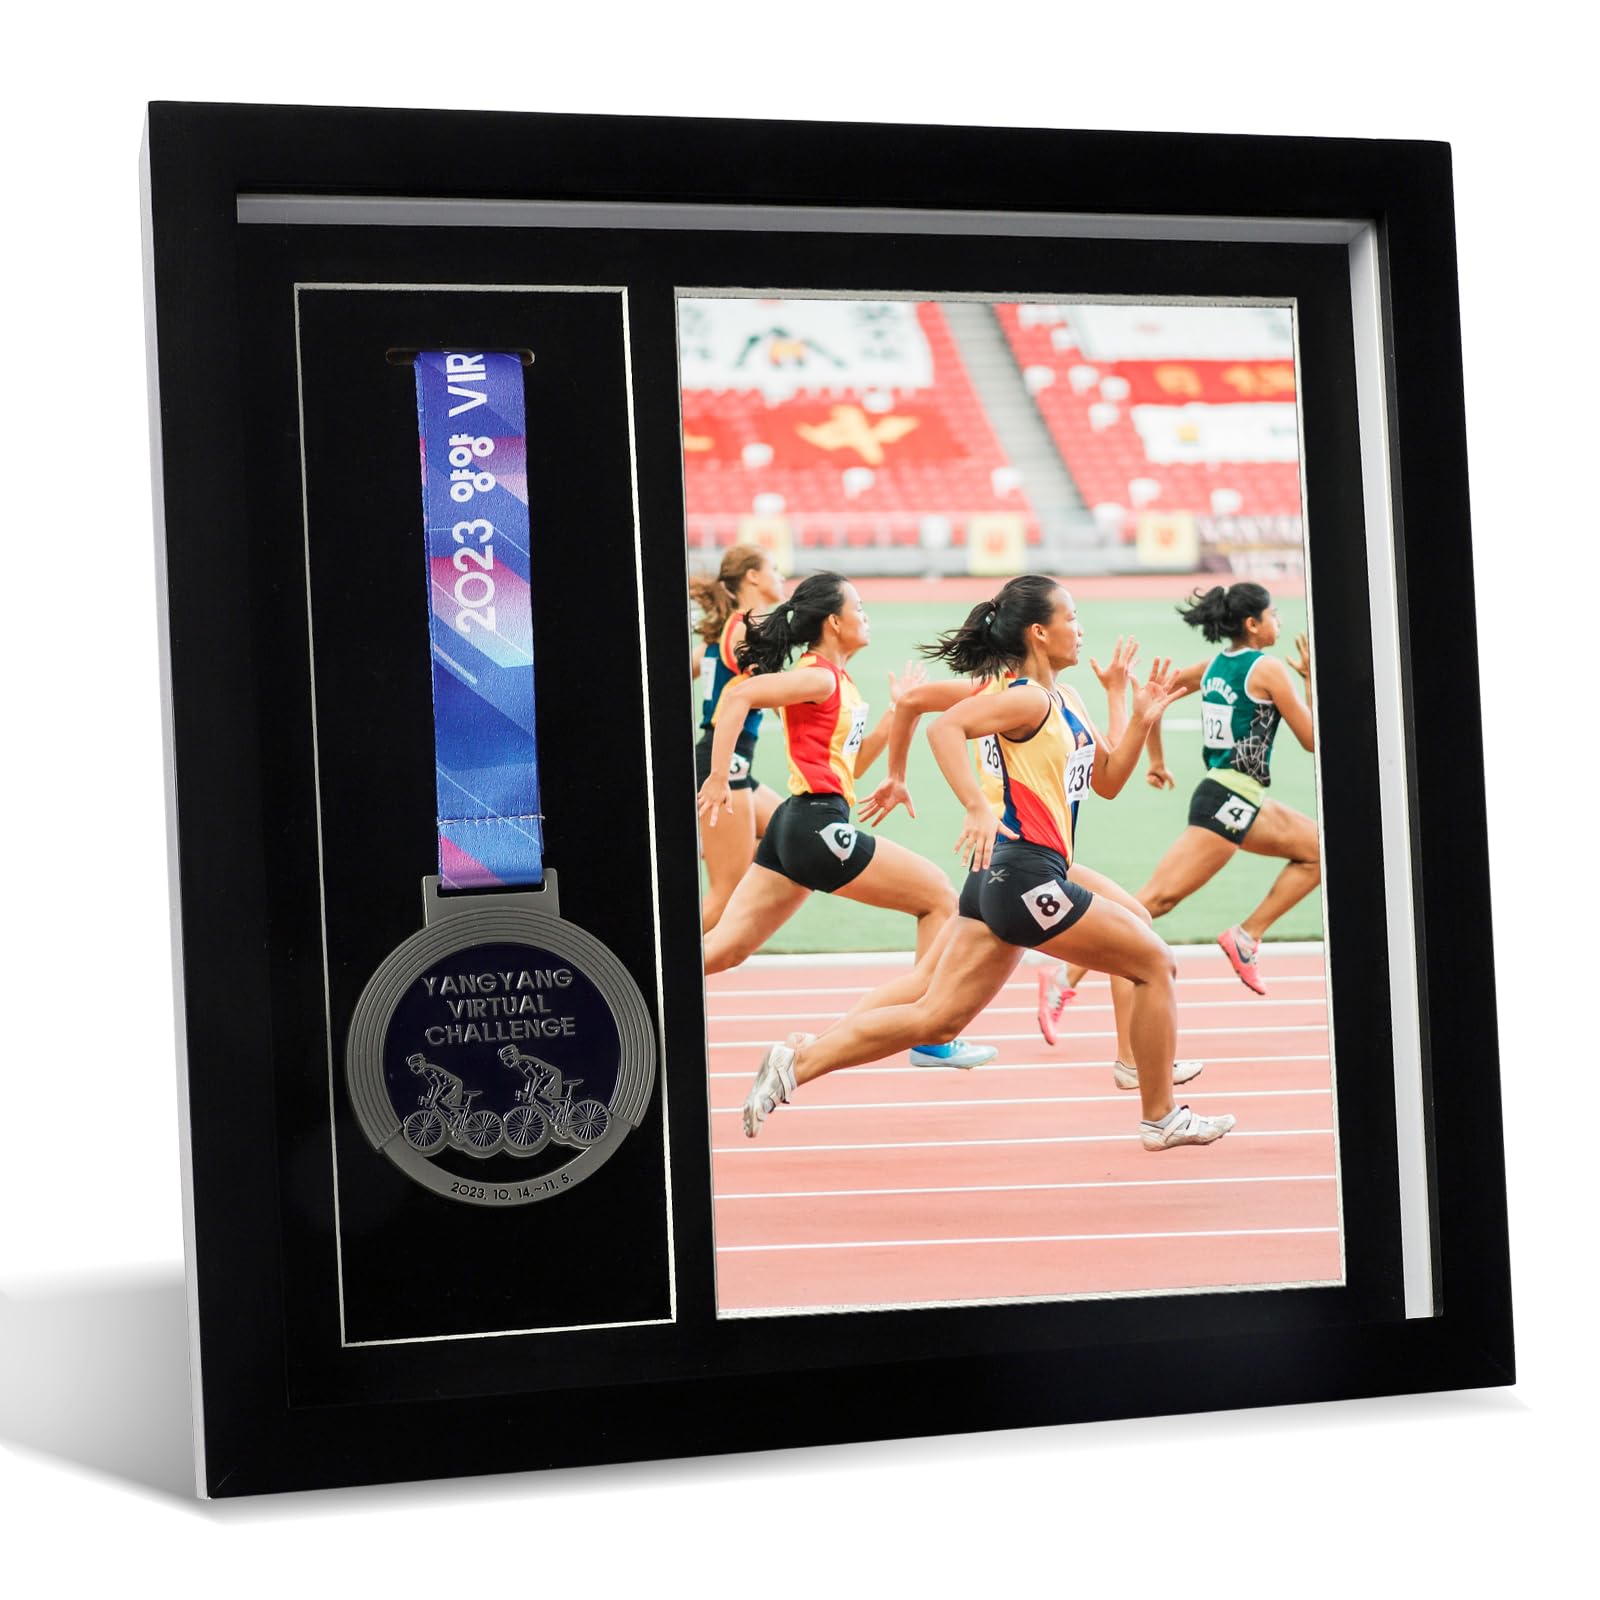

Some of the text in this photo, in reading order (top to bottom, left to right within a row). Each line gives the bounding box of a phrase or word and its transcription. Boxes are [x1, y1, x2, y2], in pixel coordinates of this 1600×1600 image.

[444, 351, 496, 634] 2023 양양 VIR
[1229, 807, 1244, 822] 4
[834, 828, 852, 849] 6
[1035, 893, 1061, 917] 8
[421, 967, 574, 997] YANGYANG
[446, 993, 552, 1019] VIRTUAL
[425, 1016, 576, 1045] CHALLENGE
[451, 1182, 487, 1200] 2023.
[494, 1189, 512, 1200] 10.
[561, 1173, 574, 1184] 5.
